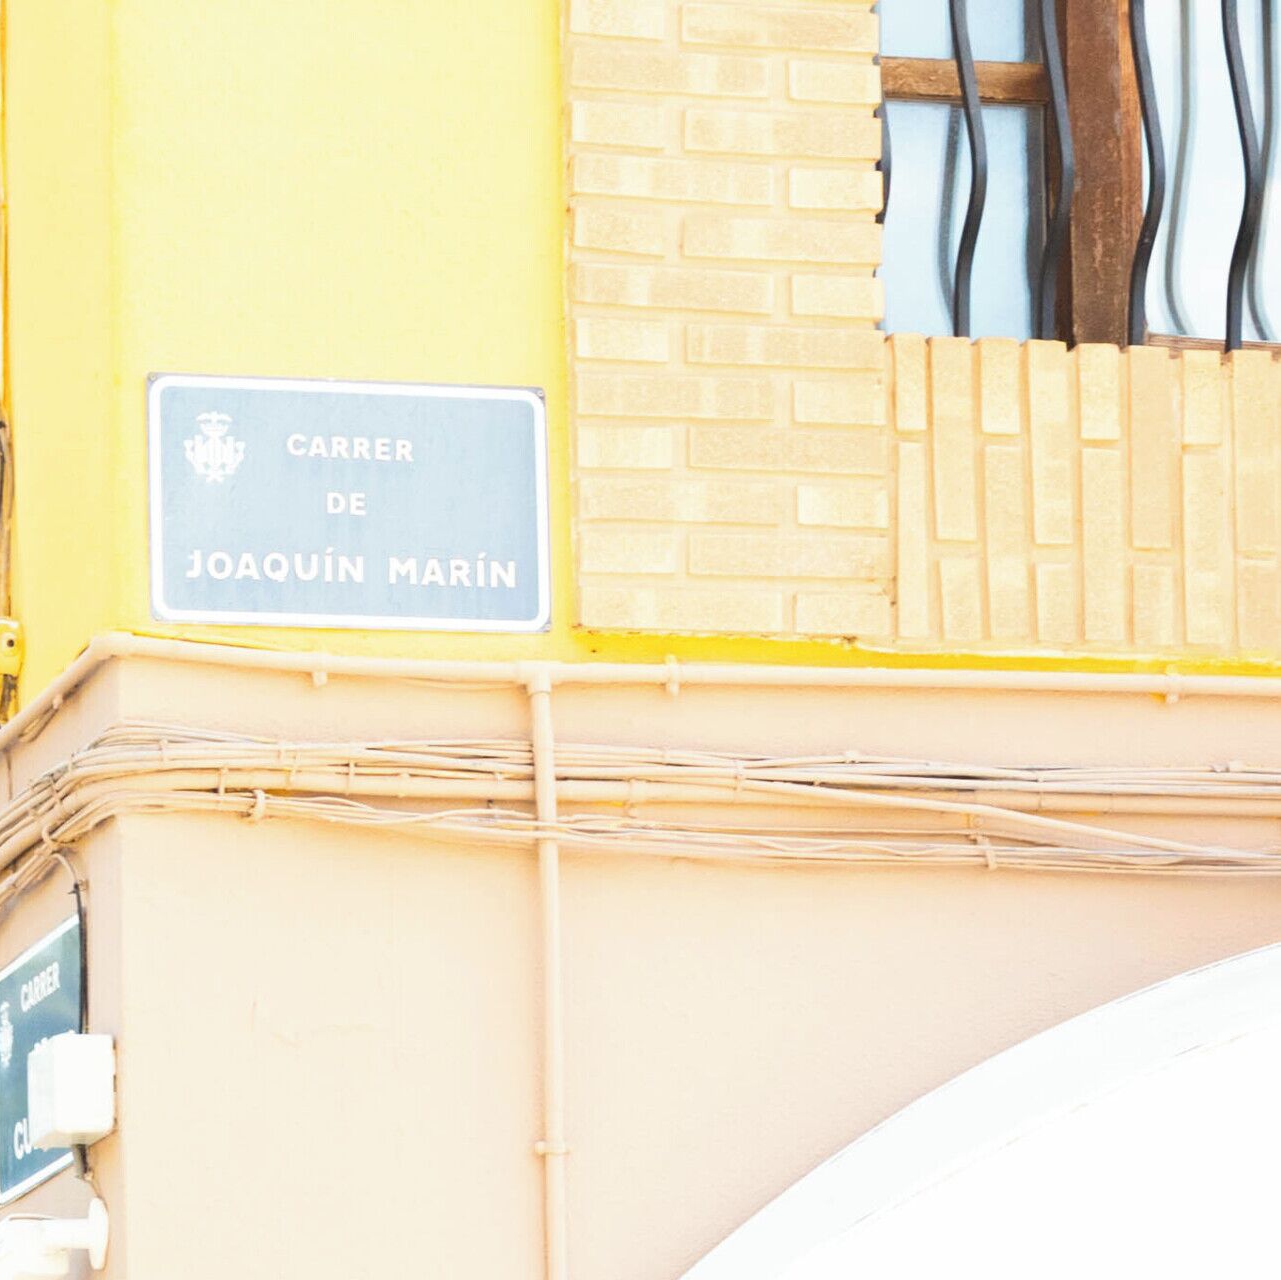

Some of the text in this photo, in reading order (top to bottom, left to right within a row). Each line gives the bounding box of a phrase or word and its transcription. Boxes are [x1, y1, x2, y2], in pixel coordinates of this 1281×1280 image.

[286, 433, 415, 463] CARRER
[325, 491, 367, 516] DE
[185, 547, 517, 589] JOAQUÍN MARÍN
[20, 961, 61, 1013] CARRER
